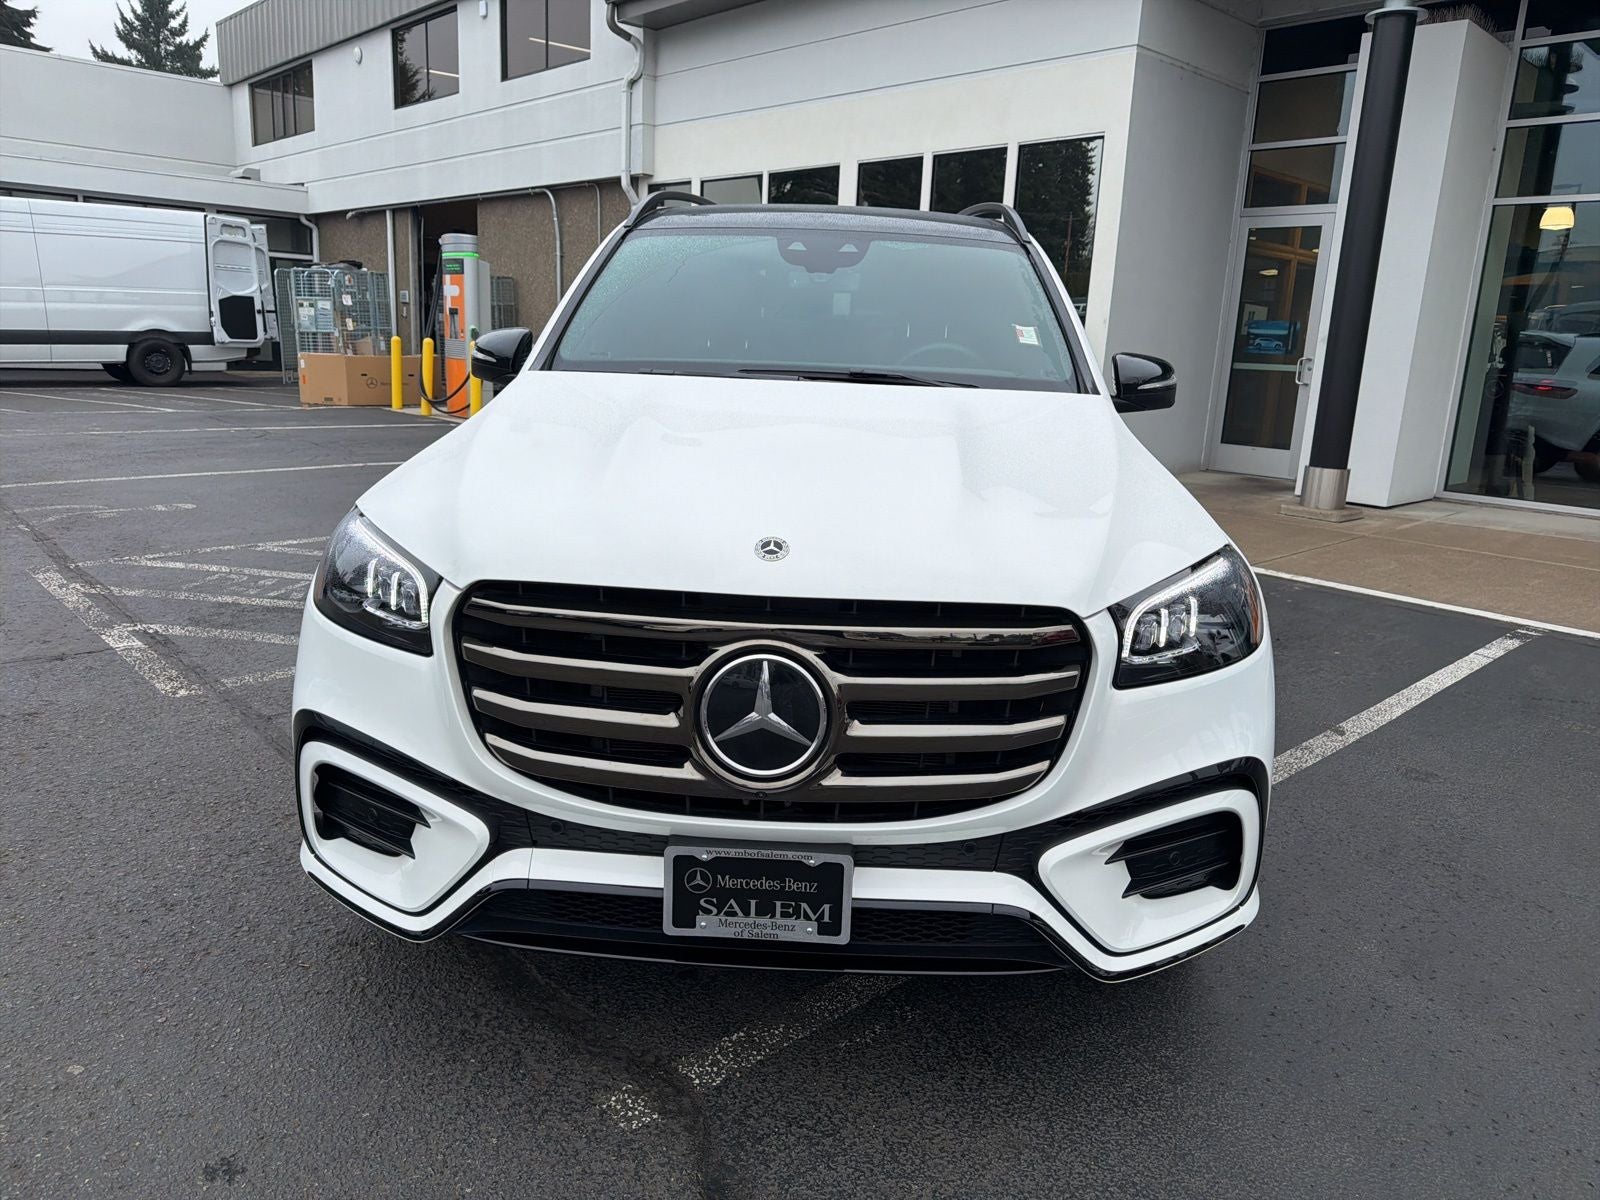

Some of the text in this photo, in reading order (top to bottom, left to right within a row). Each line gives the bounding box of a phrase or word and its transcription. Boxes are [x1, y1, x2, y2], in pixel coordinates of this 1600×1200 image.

[705, 849, 813, 860] www.mbofsalem.com
[716, 874, 818, 893] Mercedes-Benz
[698, 897, 833, 922] SALEM
[718, 918, 796, 932] Mercedes-Benz
[733, 930, 779, 939] of Salem
